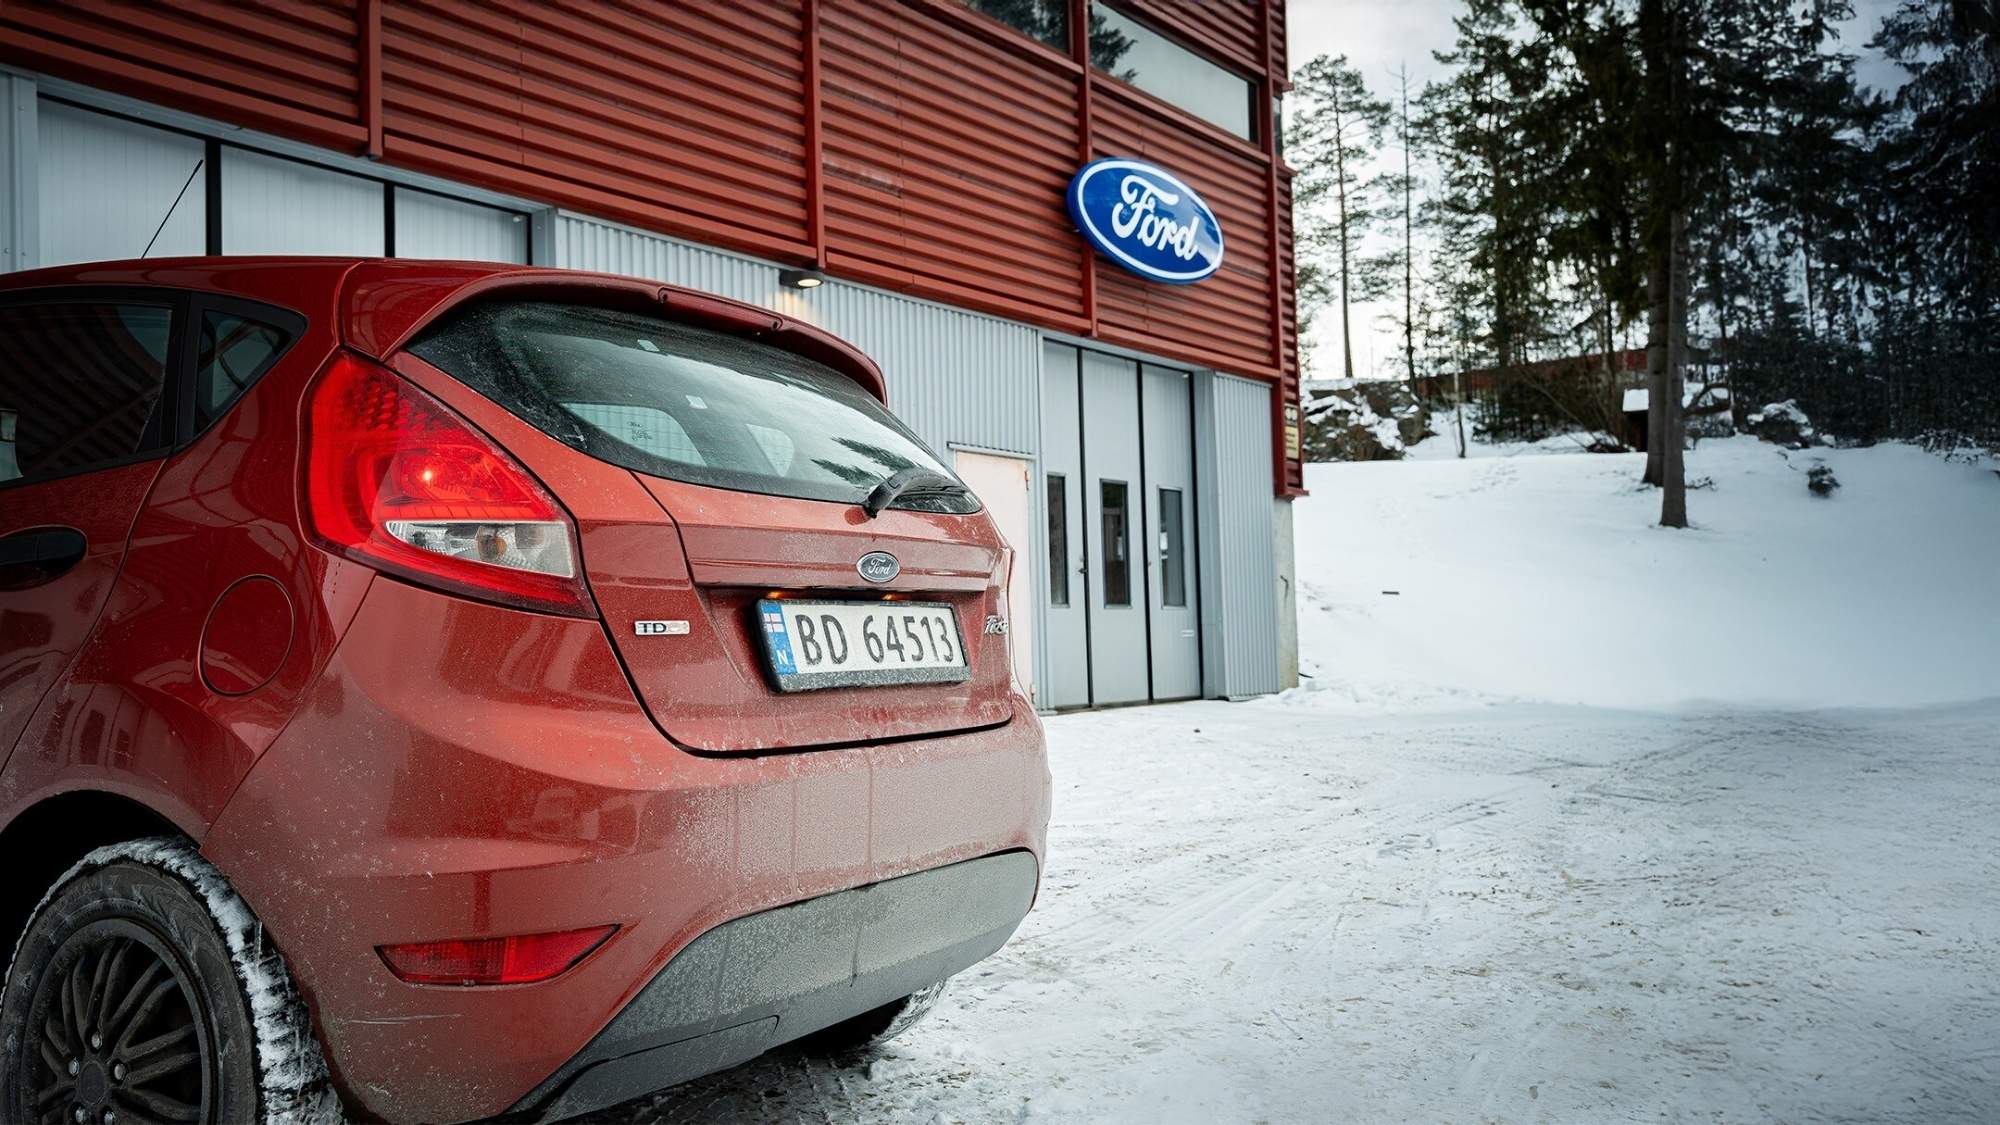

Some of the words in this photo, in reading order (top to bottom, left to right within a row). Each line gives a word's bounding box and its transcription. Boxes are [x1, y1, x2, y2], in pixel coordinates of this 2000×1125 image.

[1112, 174, 1200, 261] Ford
[868, 557, 892, 575] Ford
[776, 650, 789, 665] N
[795, 614, 848, 666] BD
[863, 615, 954, 664] 64513
